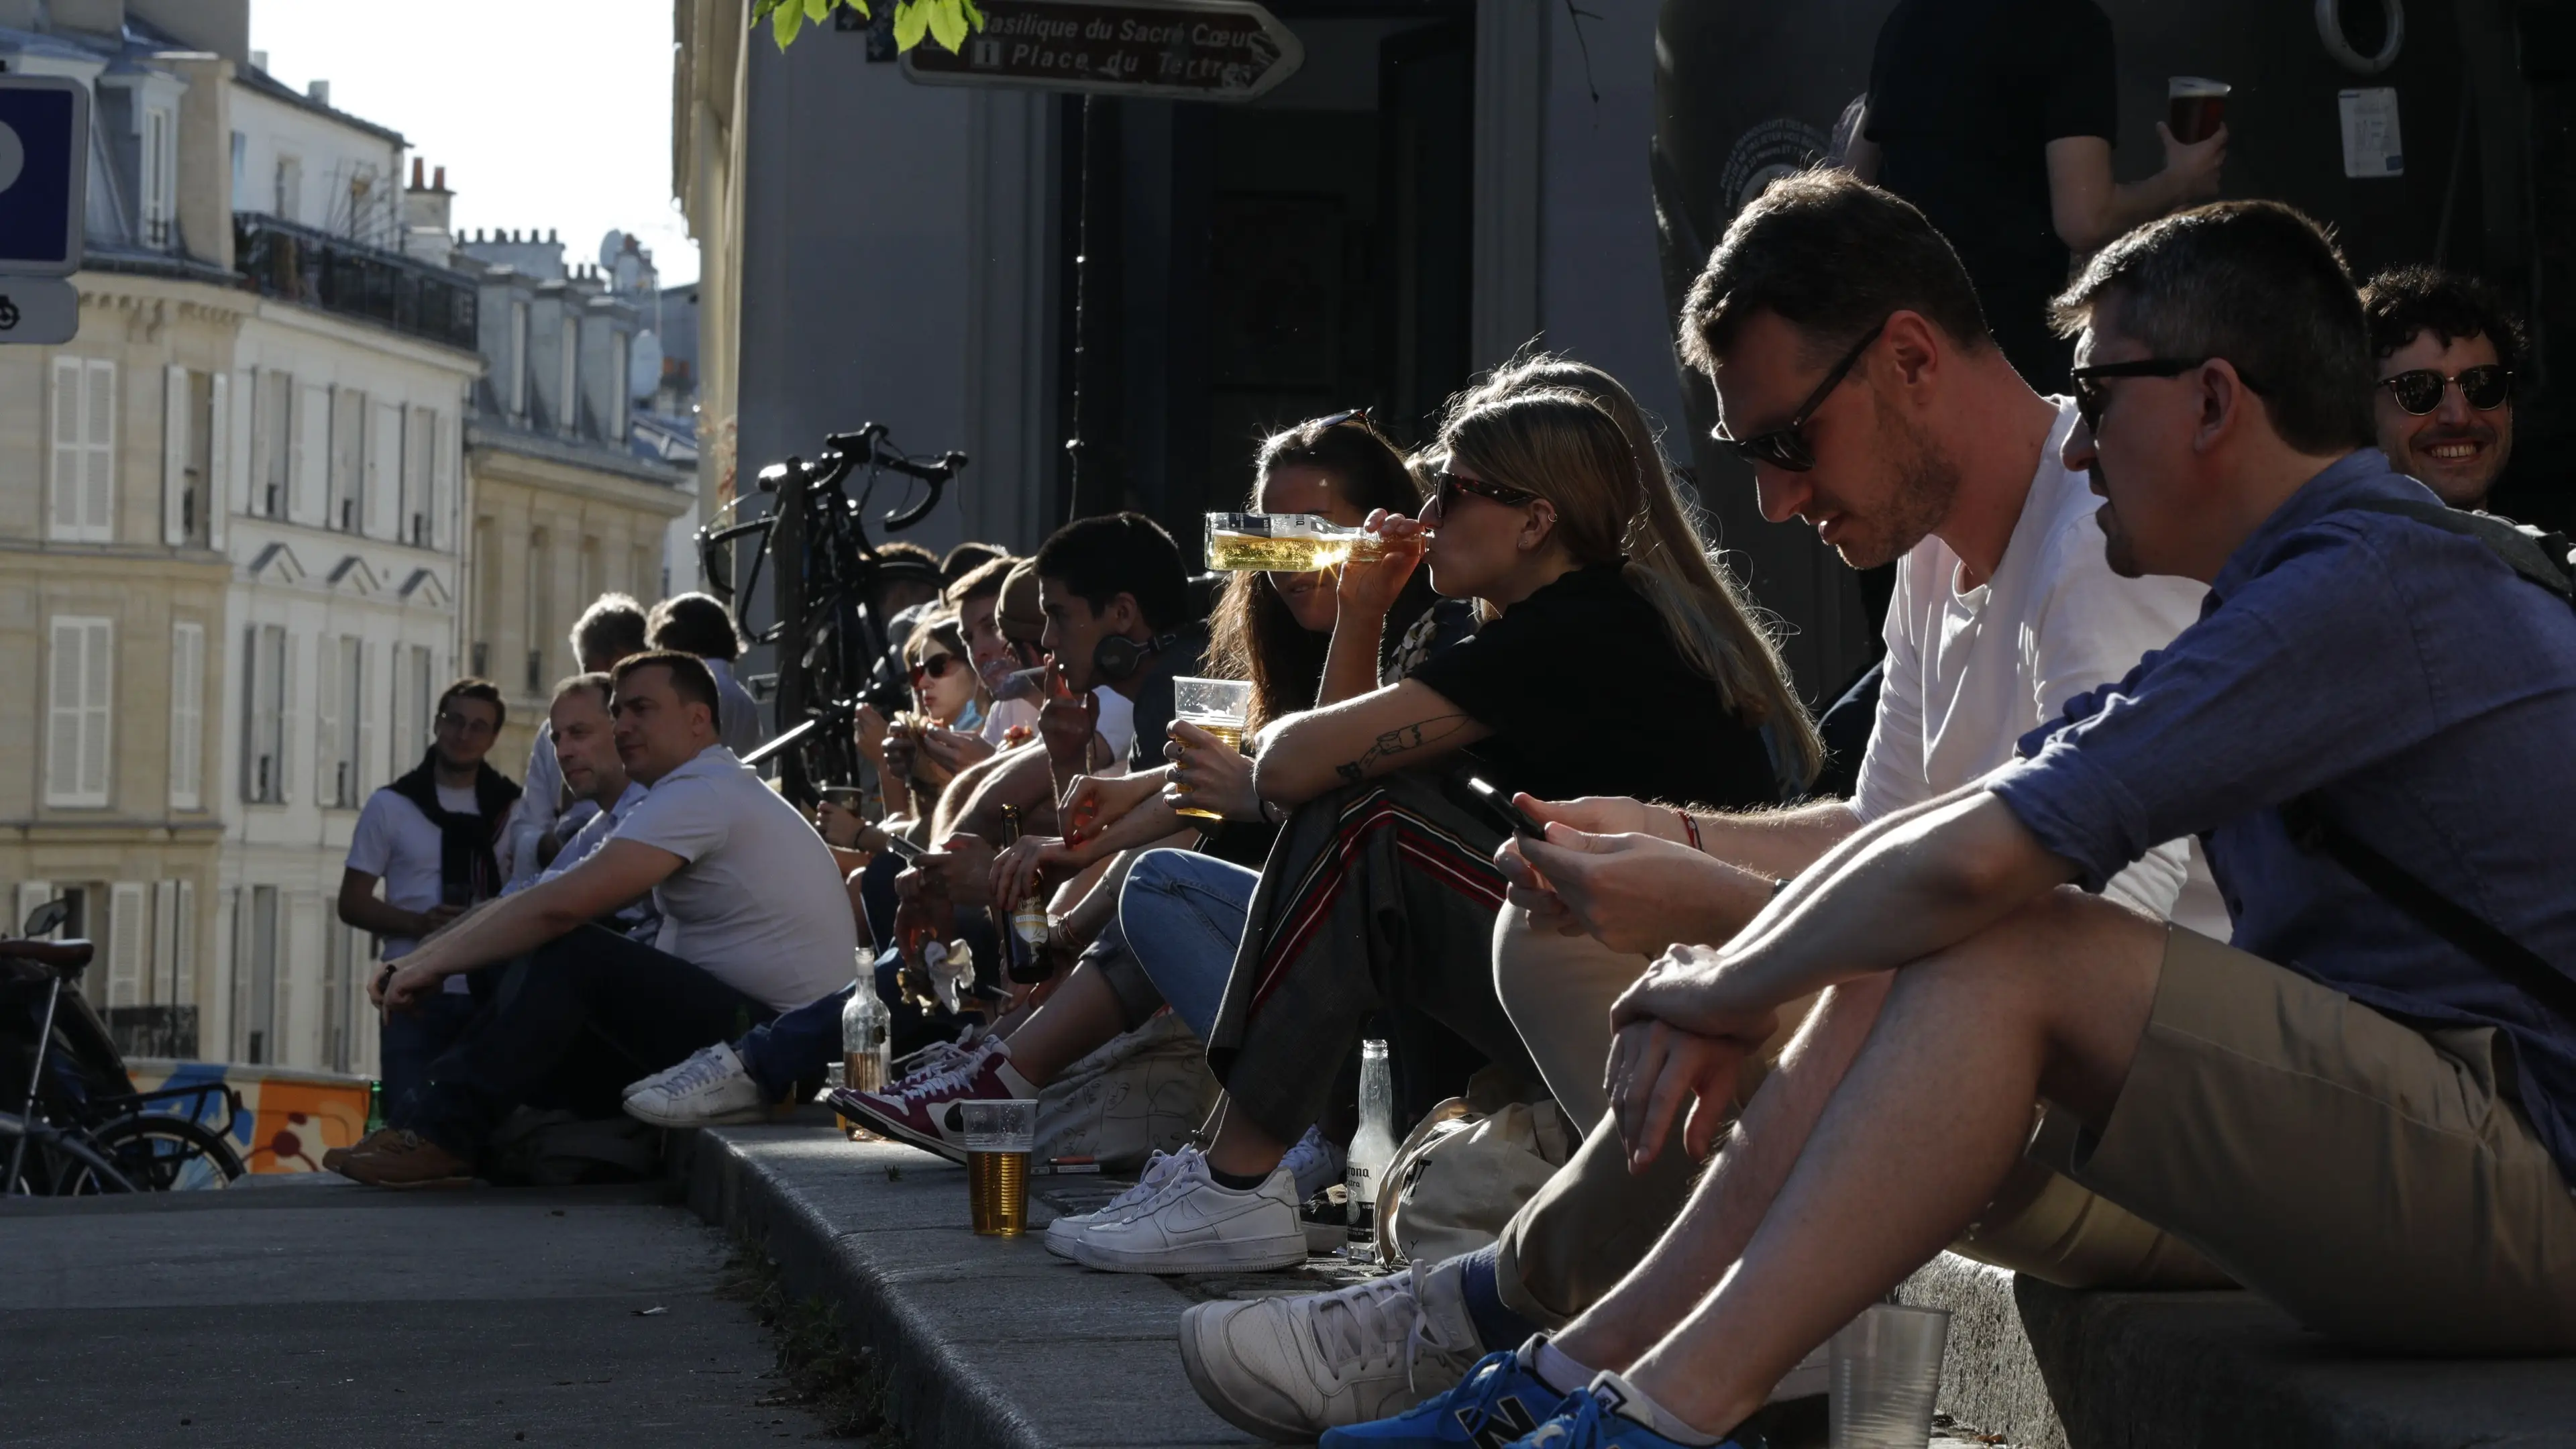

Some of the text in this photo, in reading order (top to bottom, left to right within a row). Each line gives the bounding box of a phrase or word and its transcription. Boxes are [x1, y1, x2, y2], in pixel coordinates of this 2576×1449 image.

[1085, 17, 1114, 40] du
[1119, 18, 1186, 44] Sacré
[1012, 44, 1089, 70] Place
[1106, 50, 1139, 72] du
[1348, 1167, 1369, 1177] rona
